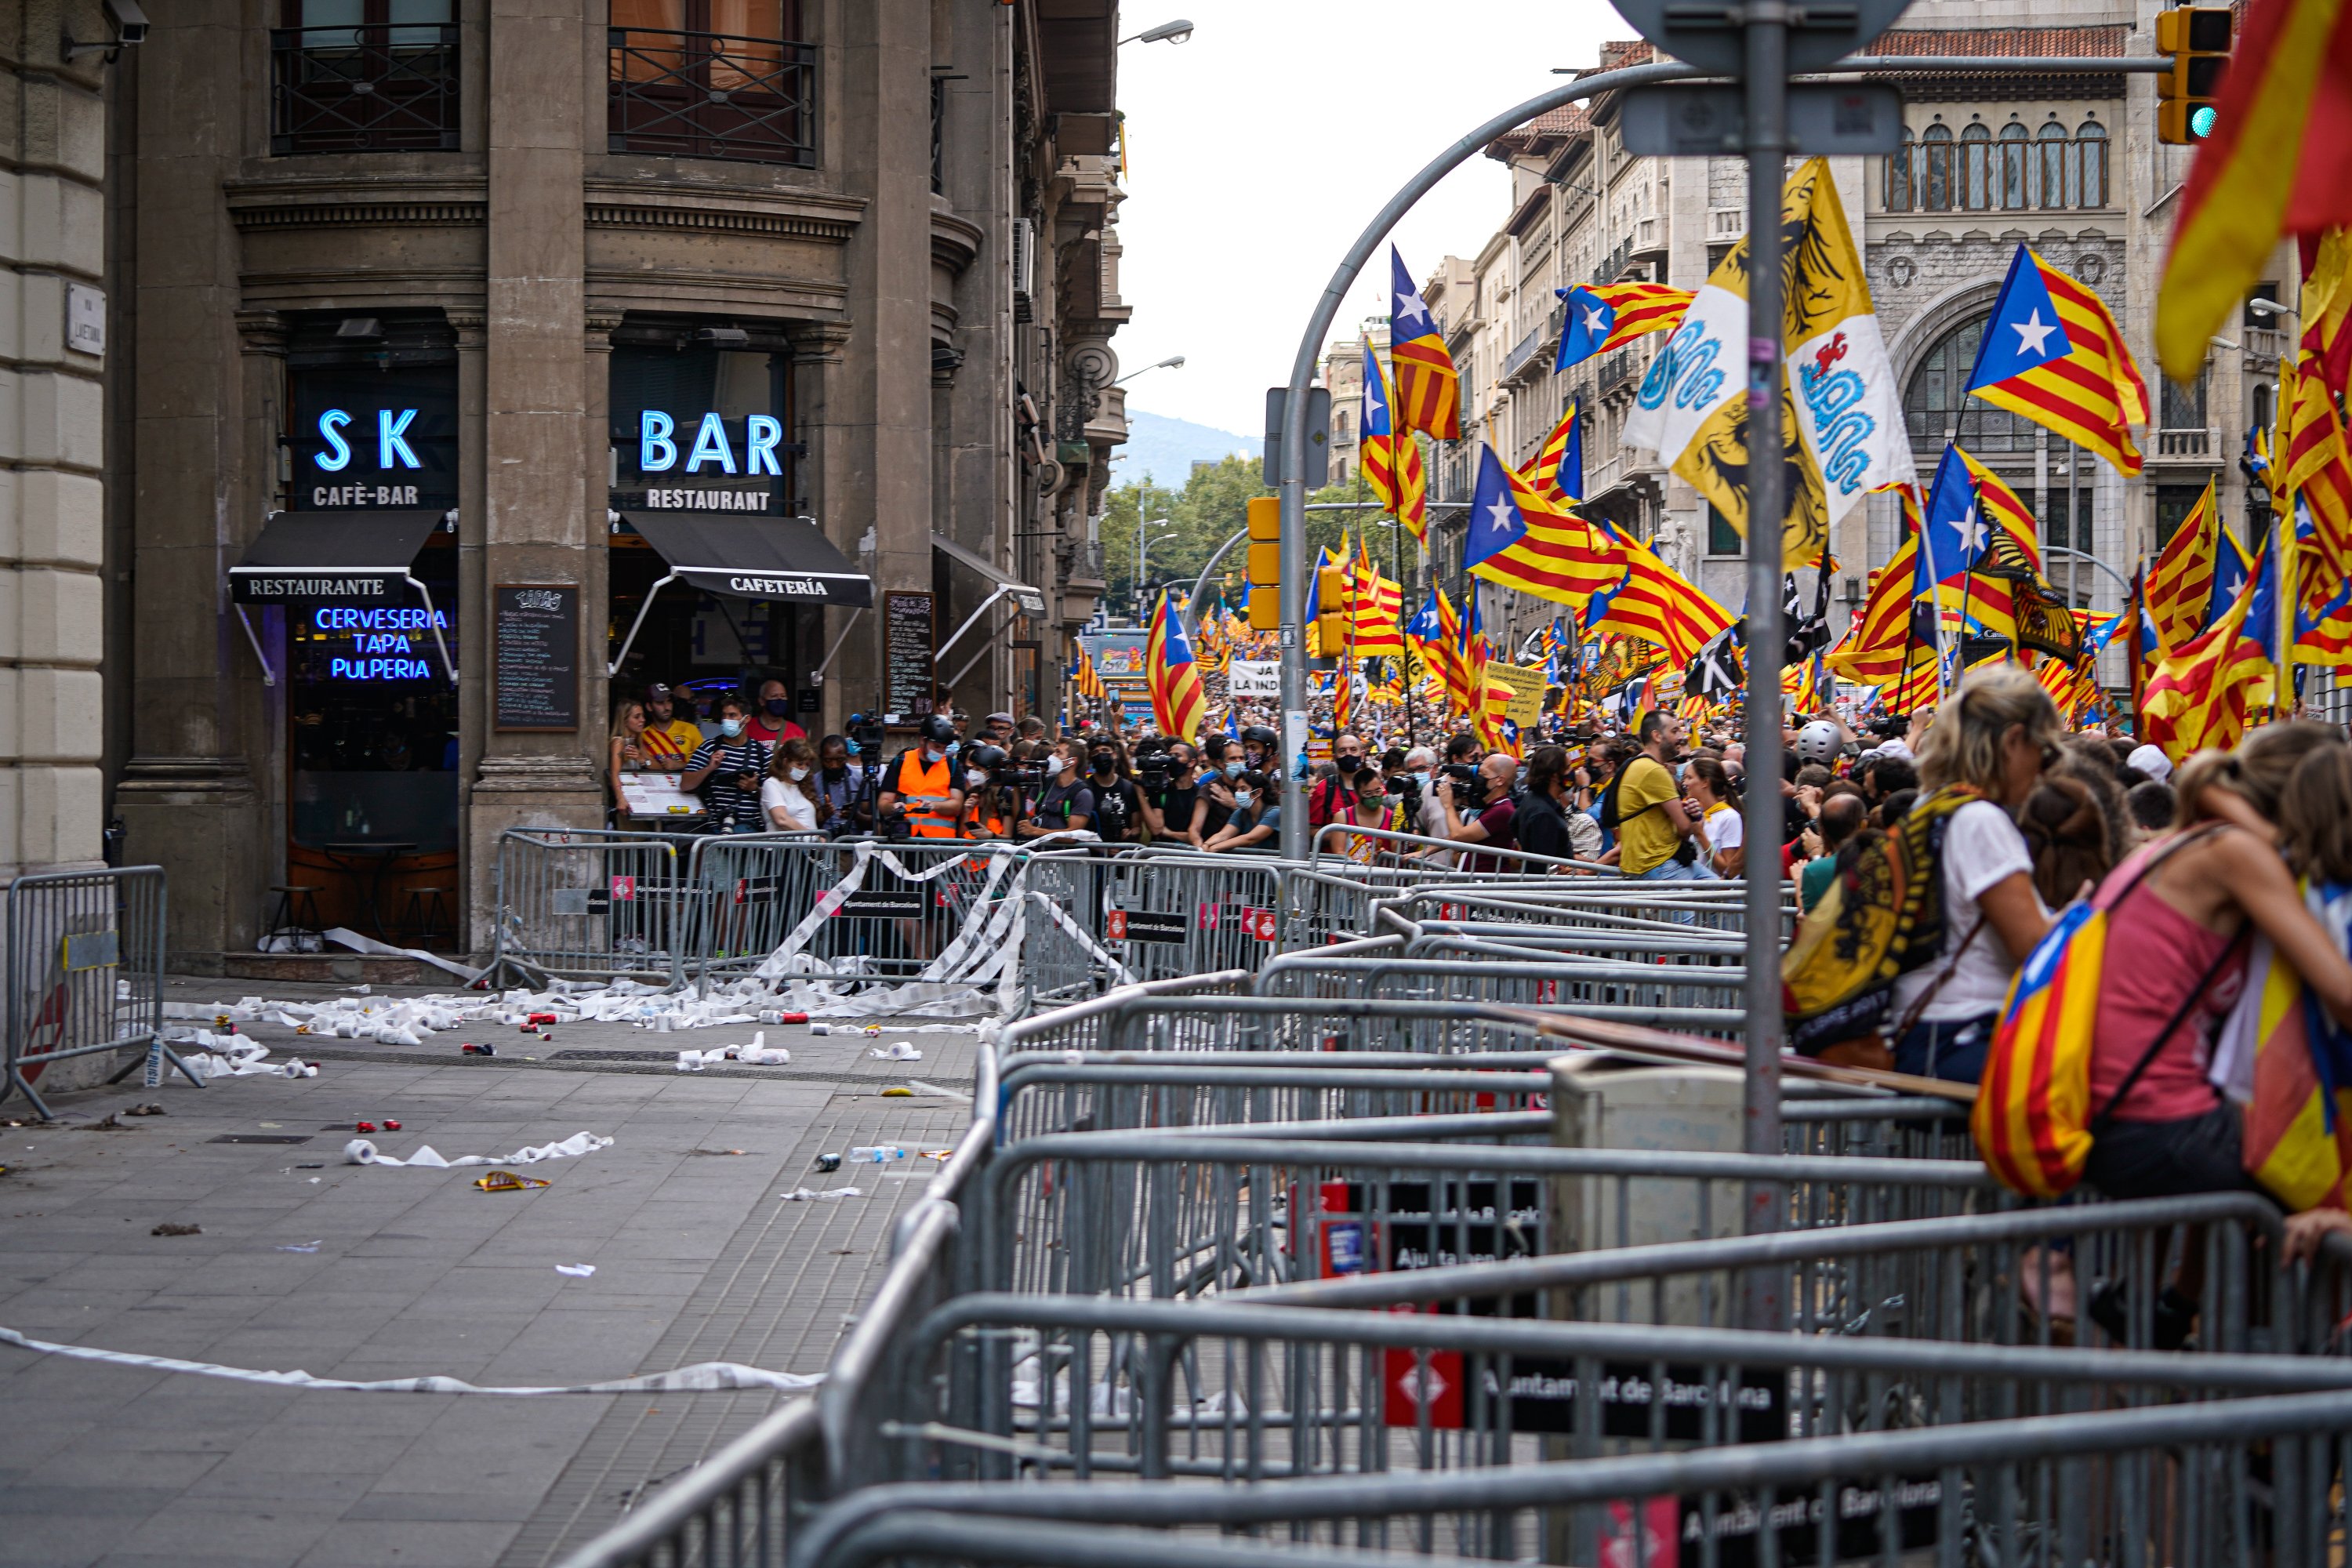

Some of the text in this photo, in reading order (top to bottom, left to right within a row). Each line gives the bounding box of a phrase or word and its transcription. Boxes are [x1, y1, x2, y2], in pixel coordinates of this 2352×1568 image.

[640, 410, 782, 475] BAR
[314, 482, 419, 506] CAFÈ-BAR
[648, 489, 770, 510] RESTAURANT
[249, 579, 384, 595] RESTAURANTE
[730, 577, 828, 596] CAFETERÍA
[316, 608, 448, 629] CERVESERIA
[353, 633, 411, 653] TAPA
[332, 659, 430, 679] PULPERIA
[1235, 681, 1251, 690] LA
[1127, 921, 1153, 930] Ajuntament
[1160, 924, 1186, 933] Barcelona
[1621, 1374, 1652, 1403] de
